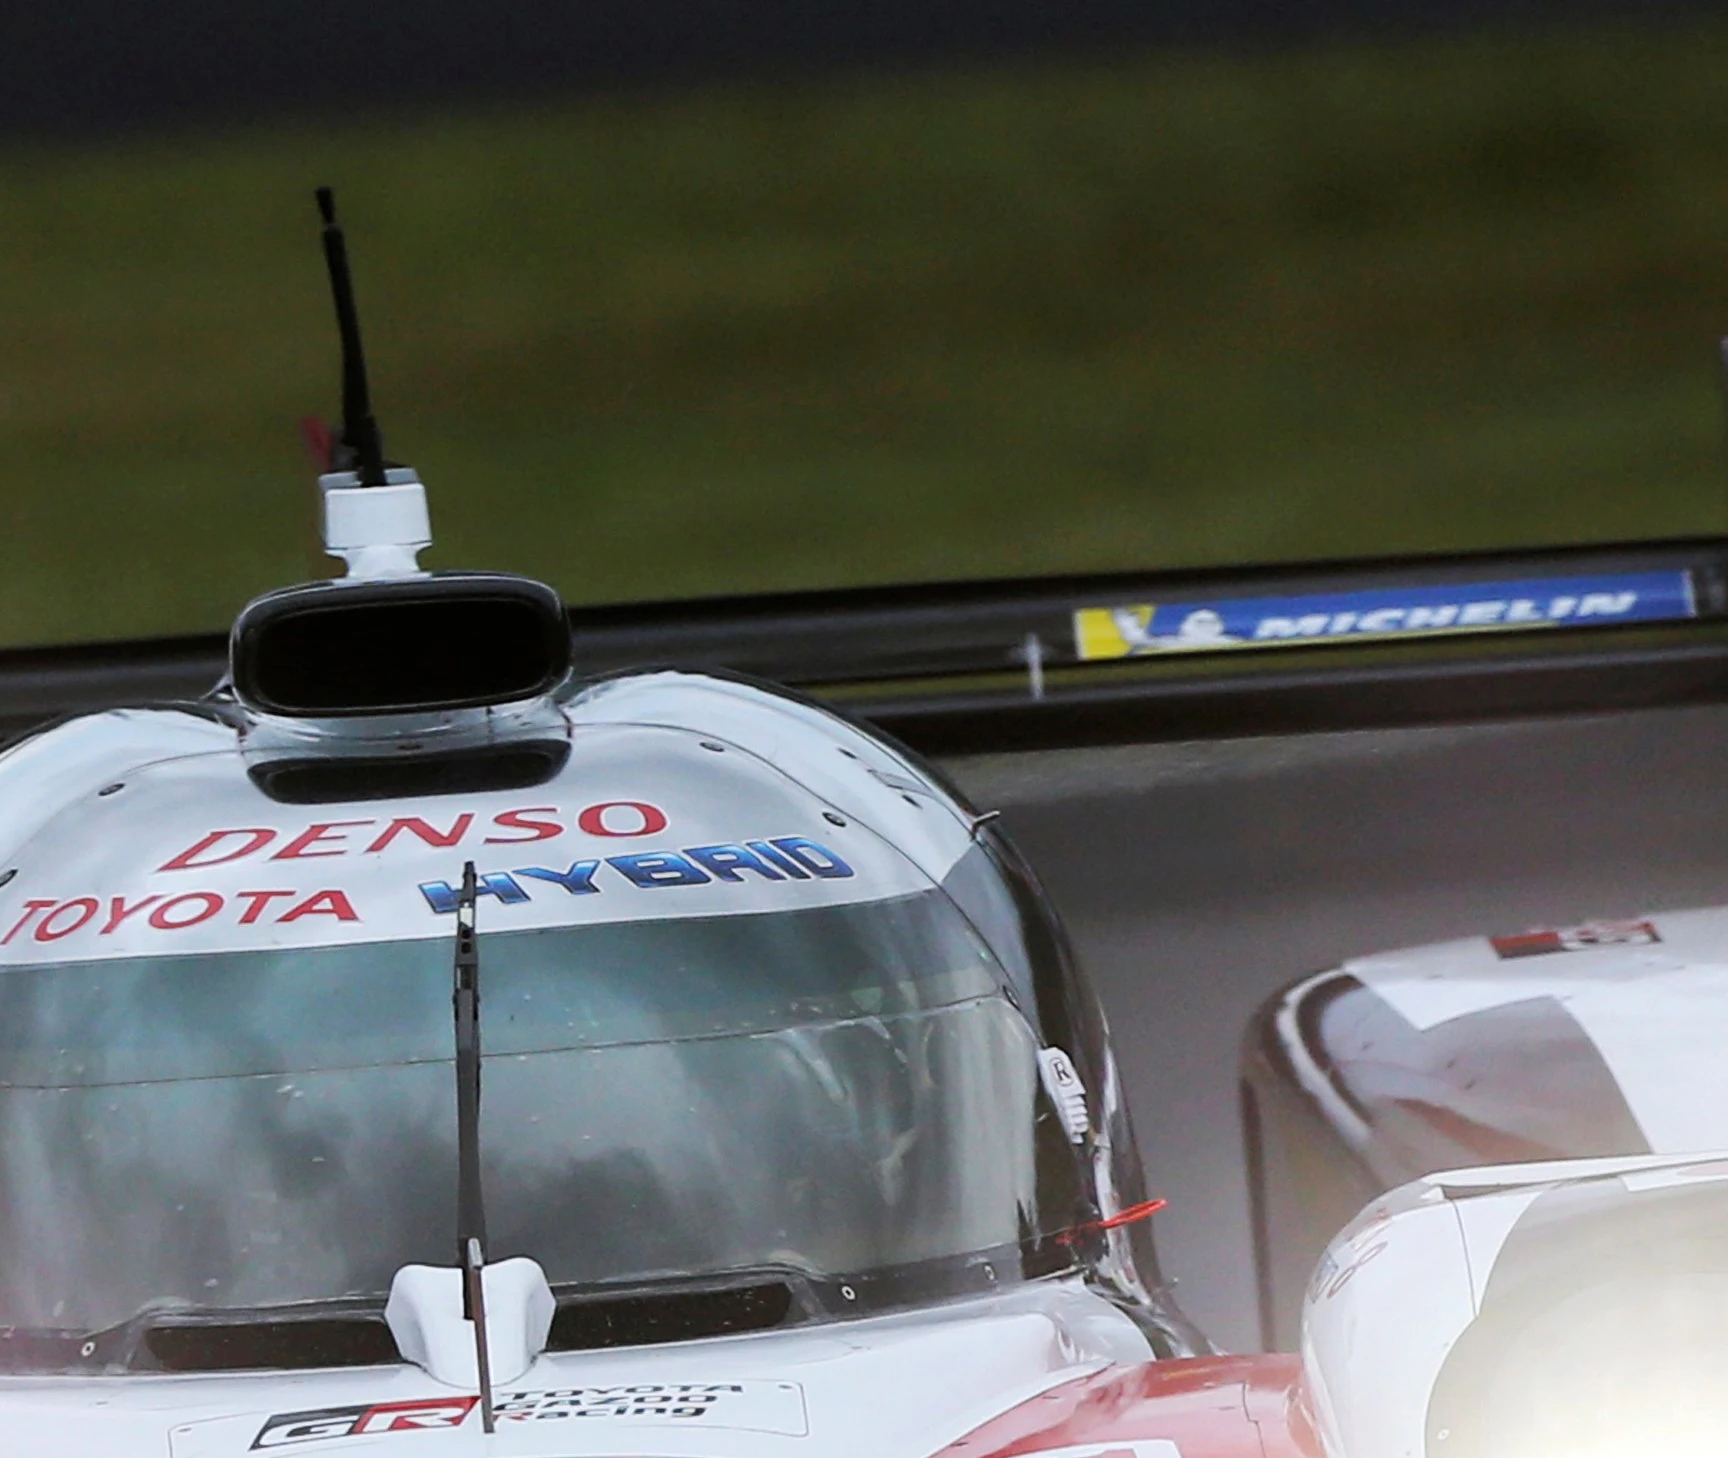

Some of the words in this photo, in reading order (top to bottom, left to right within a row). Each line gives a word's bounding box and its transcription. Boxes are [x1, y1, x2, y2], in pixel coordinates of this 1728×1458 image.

[1255, 592, 1637, 640] MICHELIN
[156, 800, 668, 873] DENSO
[0, 888, 359, 946] TOYOTA
[418, 834, 855, 915] HYBRID
[492, 1395, 718, 1411] GAZOO
[492, 1406, 706, 1421] Racing
[500, 1385, 743, 1401] TOYOTA
[248, 1395, 482, 1451] GR
